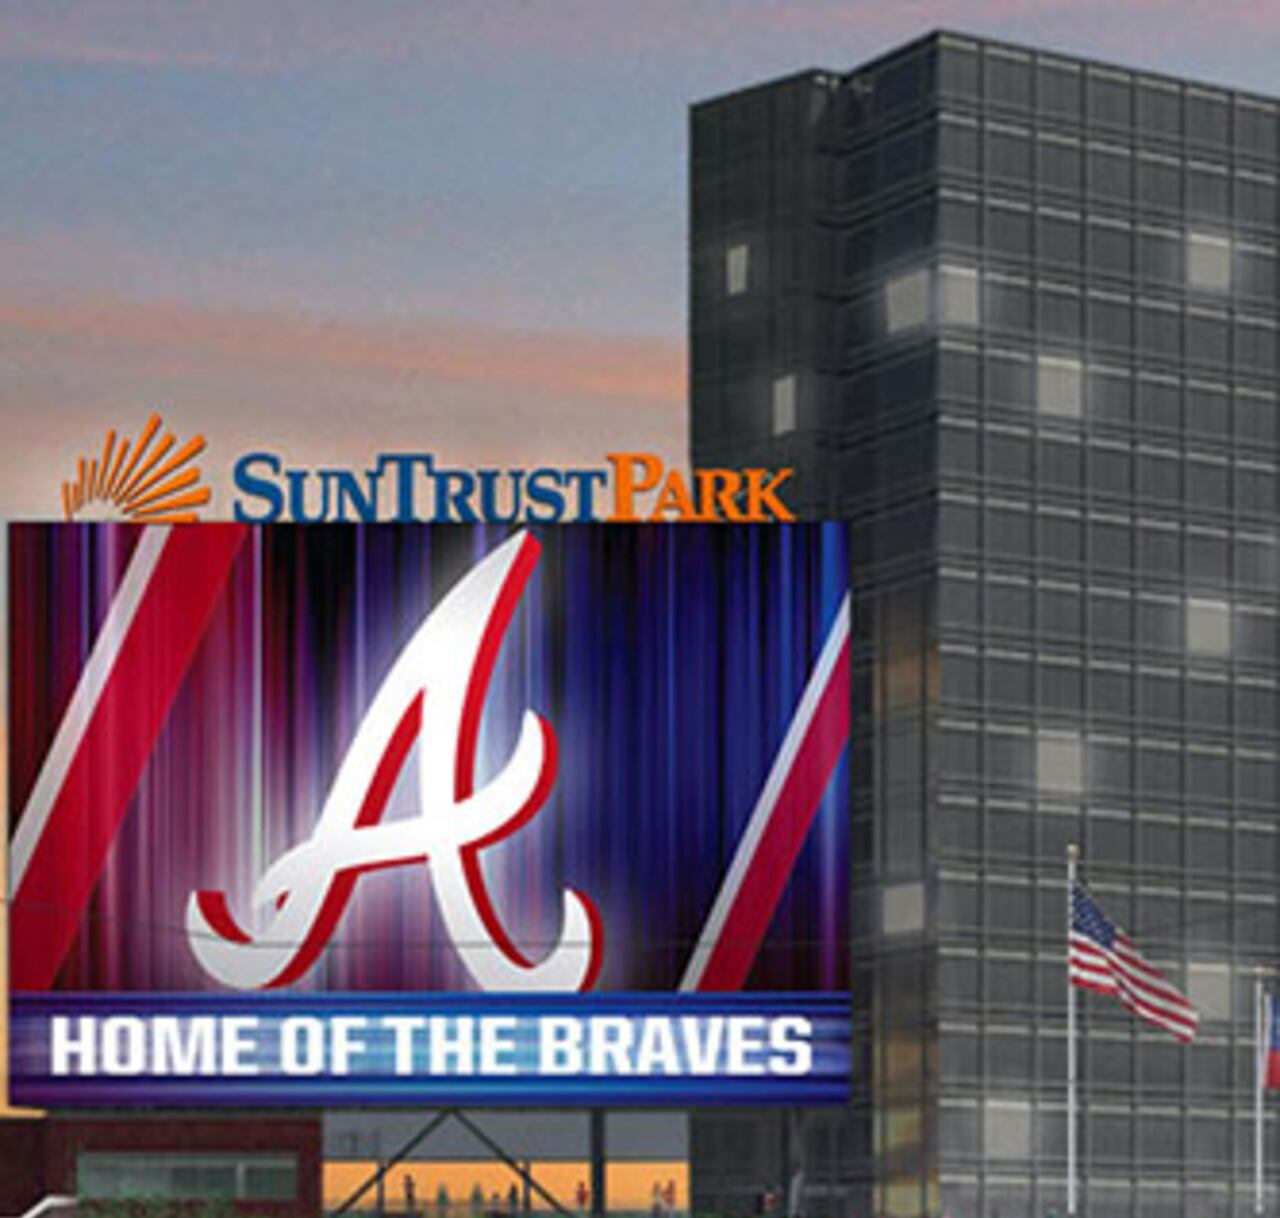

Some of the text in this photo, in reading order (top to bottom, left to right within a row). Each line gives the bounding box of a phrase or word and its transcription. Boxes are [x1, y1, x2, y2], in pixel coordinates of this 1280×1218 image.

[50, 1016, 812, 1077] HOME OF THE BRAVES
